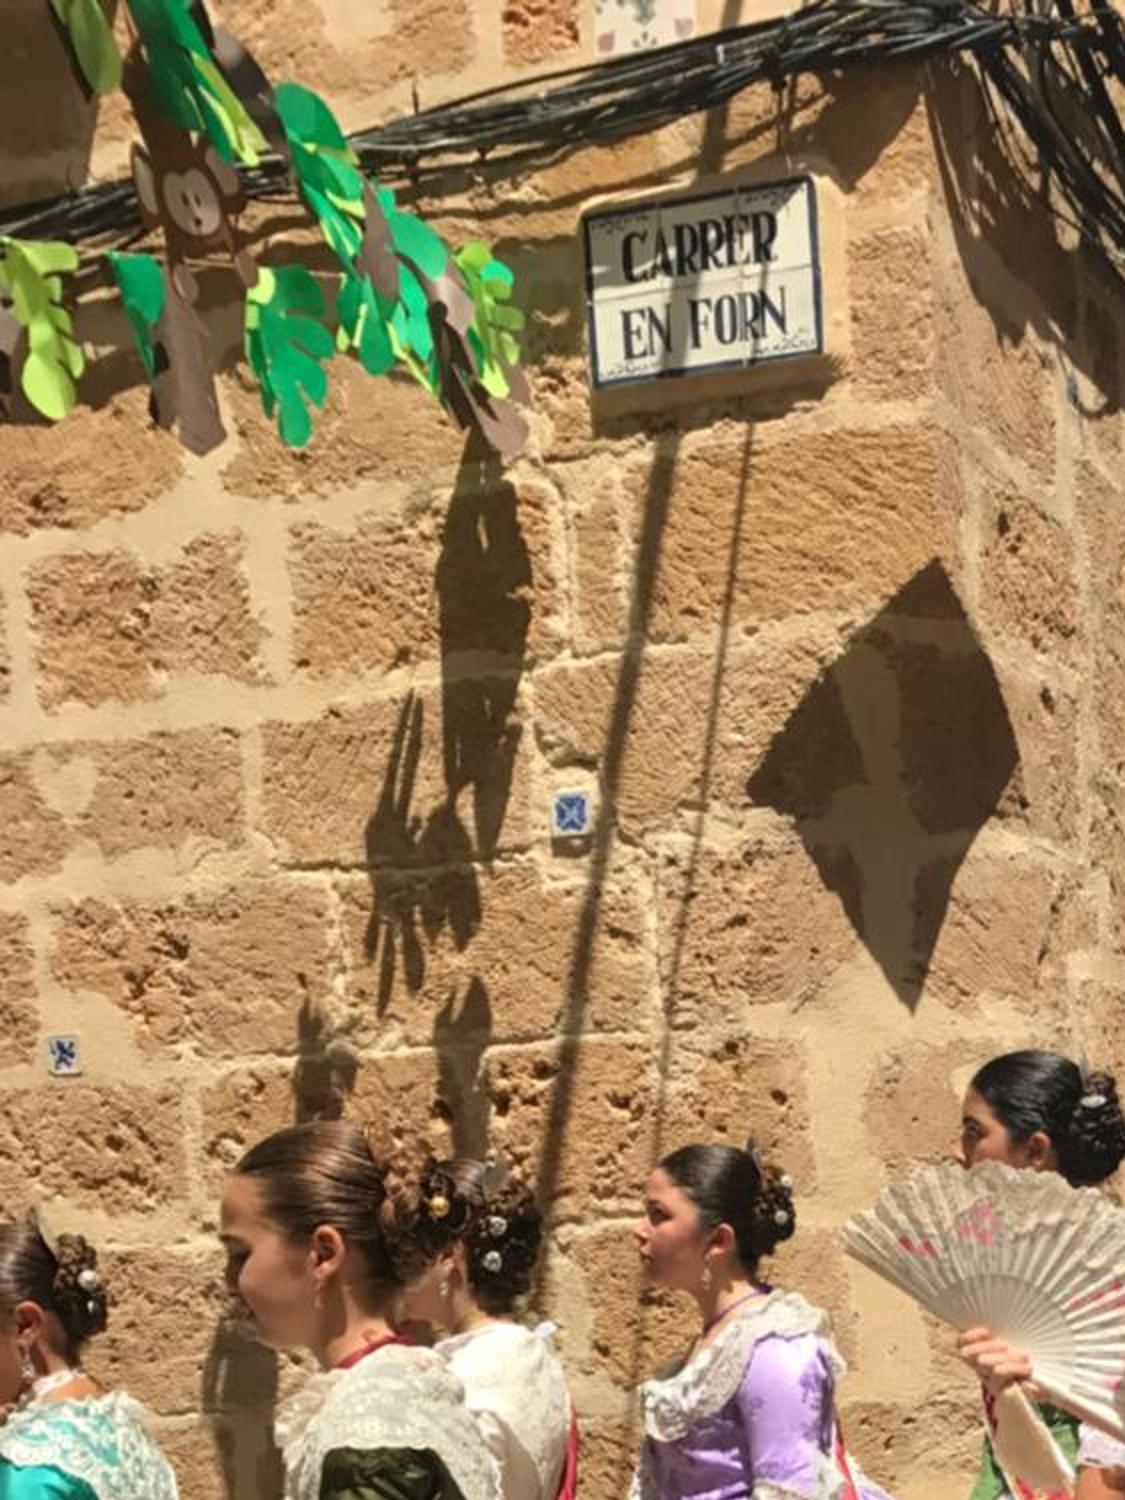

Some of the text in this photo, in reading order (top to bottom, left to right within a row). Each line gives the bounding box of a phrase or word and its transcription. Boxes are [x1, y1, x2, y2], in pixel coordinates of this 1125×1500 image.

[621, 210, 778, 283] CARRER
[620, 286, 787, 360] EN FORN
